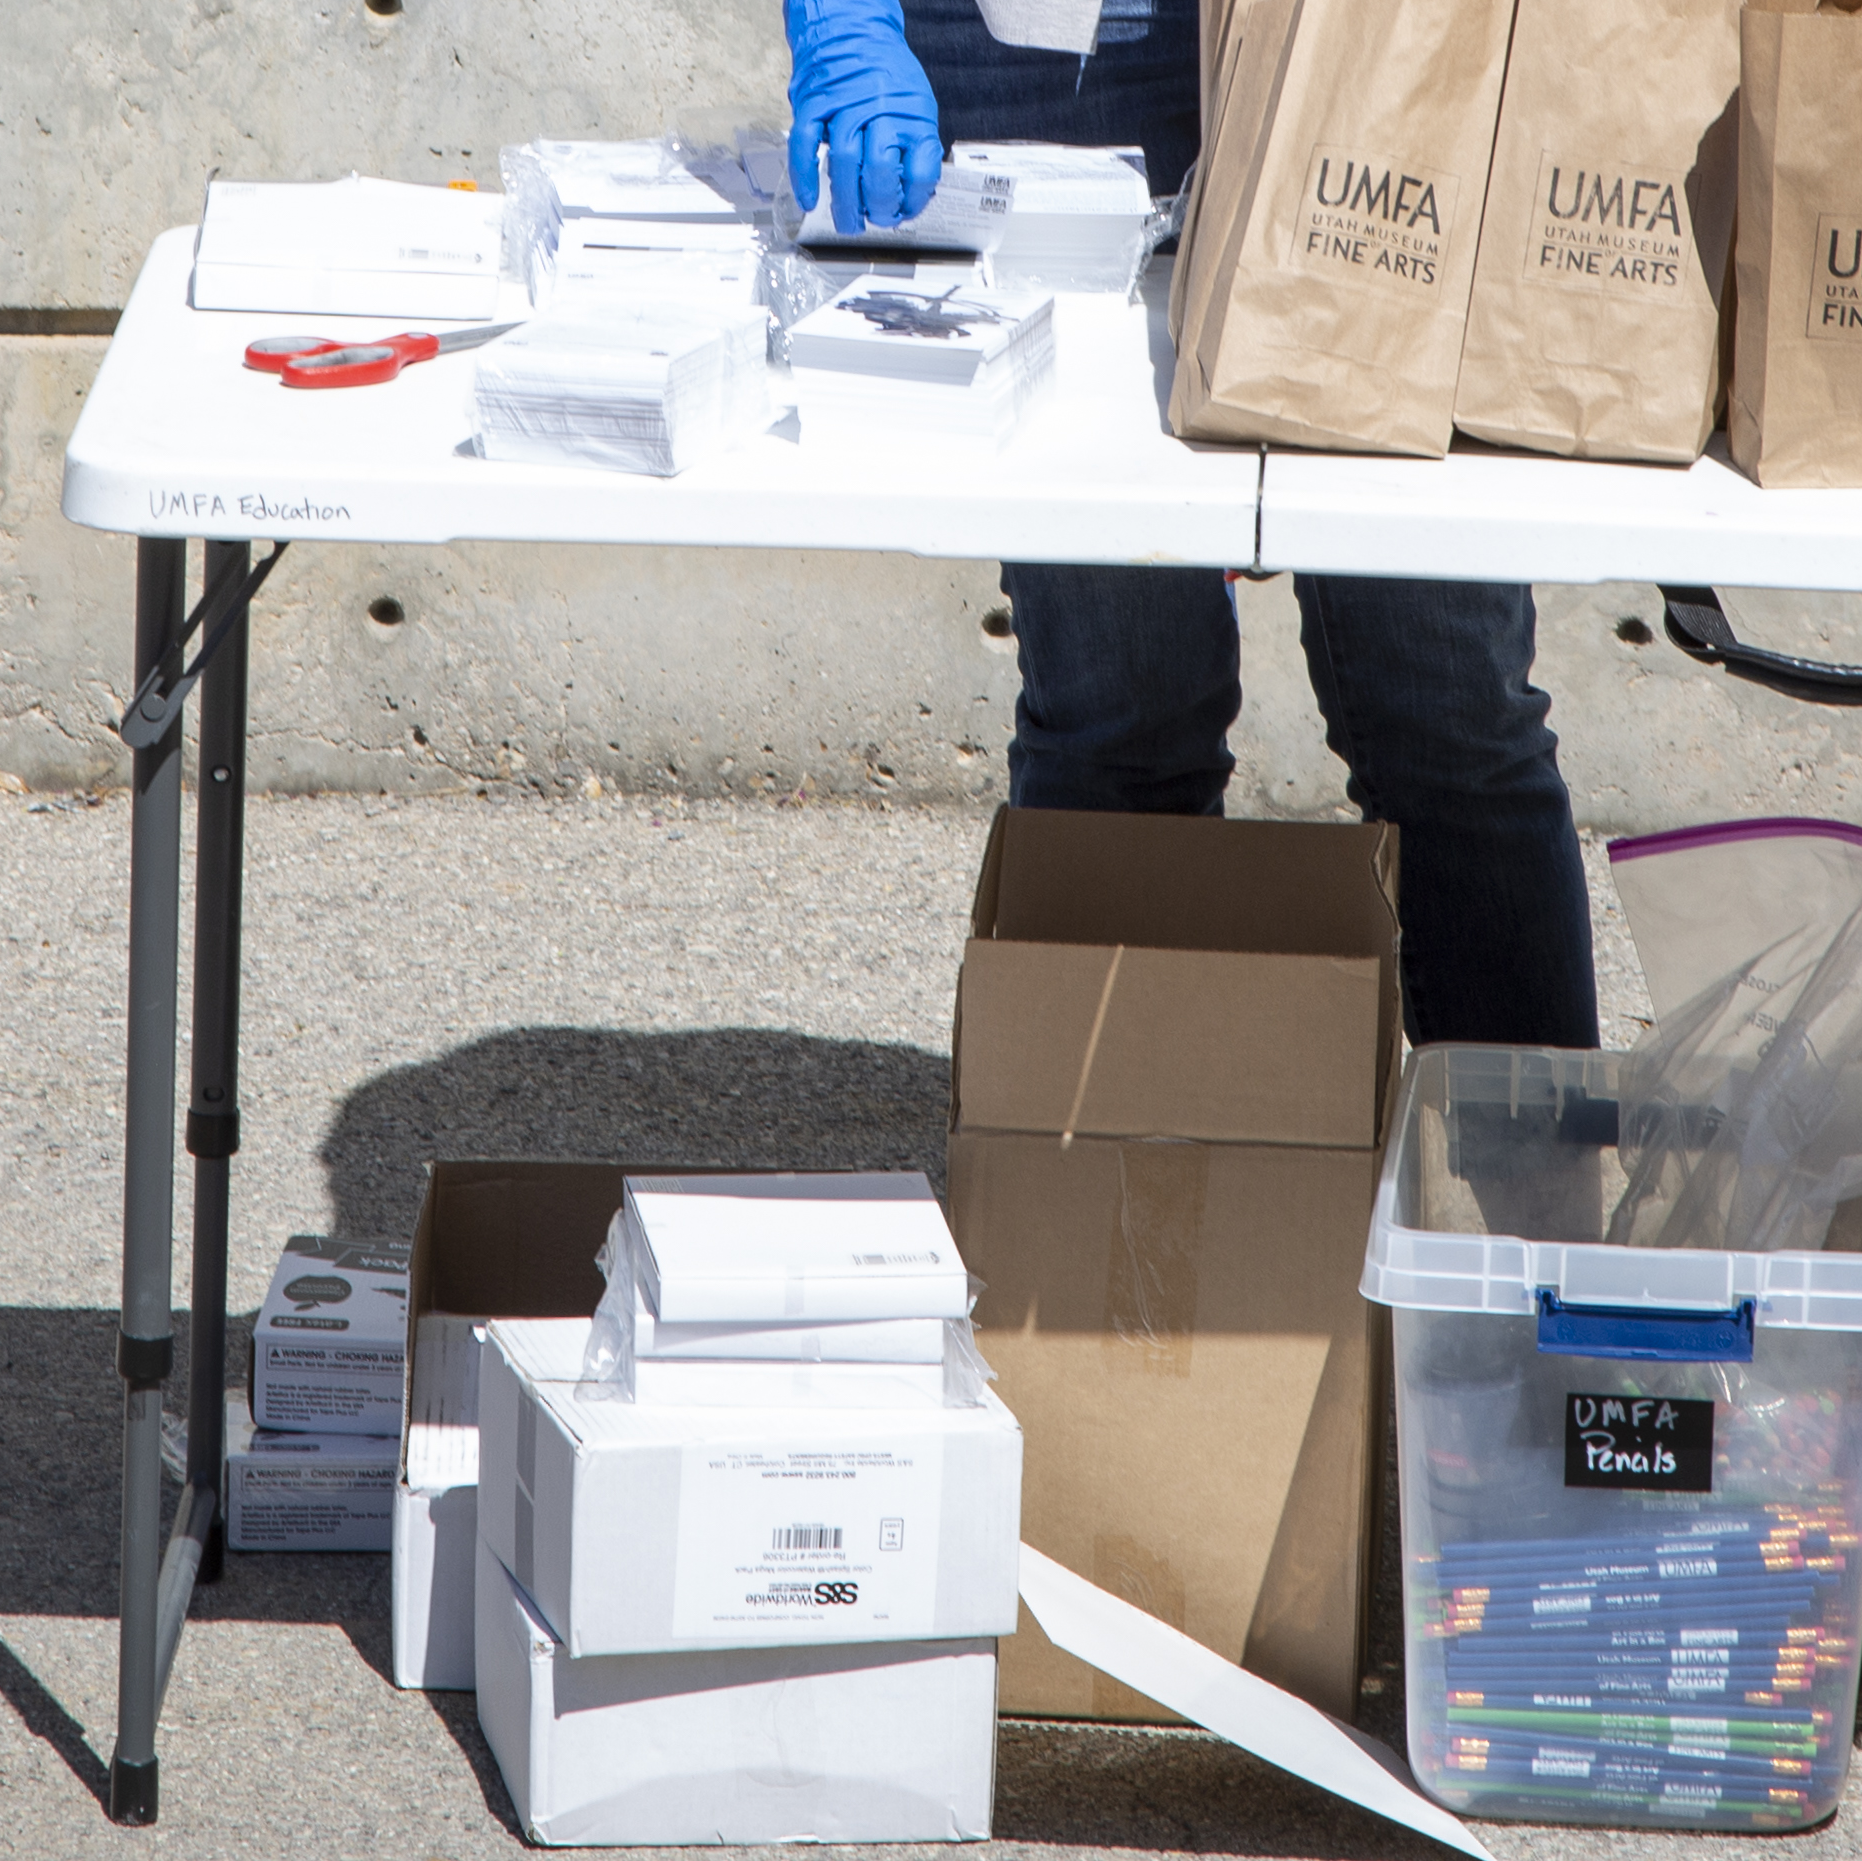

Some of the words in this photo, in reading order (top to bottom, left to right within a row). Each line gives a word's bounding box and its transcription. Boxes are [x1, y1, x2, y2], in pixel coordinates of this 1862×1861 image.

[1317, 158, 1440, 235] UMFA
[1548, 167, 1681, 237] UMFA
[1312, 213, 1358, 234] UTAH
[1363, 224, 1438, 256] MUSEUM
[1544, 225, 1590, 243] UTAH
[1597, 233, 1679, 257] MUSEUM
[1307, 232, 1368, 264] FINE
[1374, 249, 1436, 284] ARTS
[1540, 245, 1602, 275] FINE
[1609, 256, 1677, 286] ARTS
[149, 490, 227, 519] UMFA
[238, 493, 351, 520] Education
[281, 1348, 326, 1360] WARNING
[334, 1351, 379, 1362] CHOKING
[381, 1353, 404, 1363] HAZA
[1575, 1398, 1679, 1430] UMFA
[257, 1470, 302, 1479] WARNING
[310, 1470, 356, 1479] CHOKING
[1663, 1560, 1713, 1578] UMFA
[745, 1594, 812, 1607] Worldwide
[814, 1582, 858, 1605] S&S
